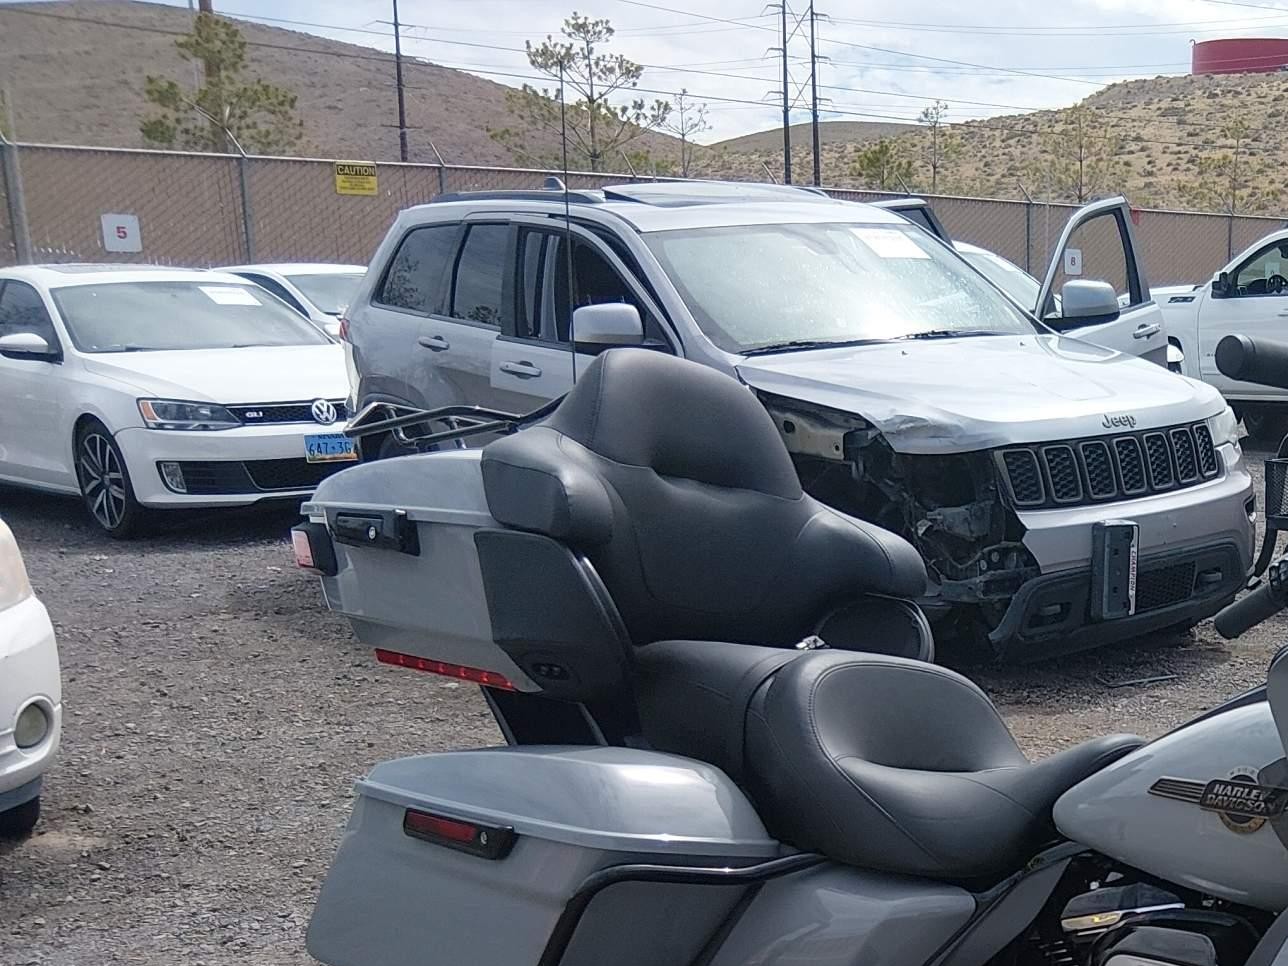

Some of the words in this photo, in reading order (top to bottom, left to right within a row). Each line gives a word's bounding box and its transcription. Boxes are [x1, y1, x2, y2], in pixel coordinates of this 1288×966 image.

[337, 165, 375, 176] CAUTION
[116, 226, 127, 239] 5
[1102, 414, 1137, 429] Jeep
[1129, 551, 1137, 592] CHAMPION
[1206, 794, 1277, 813] DAVIDSON
